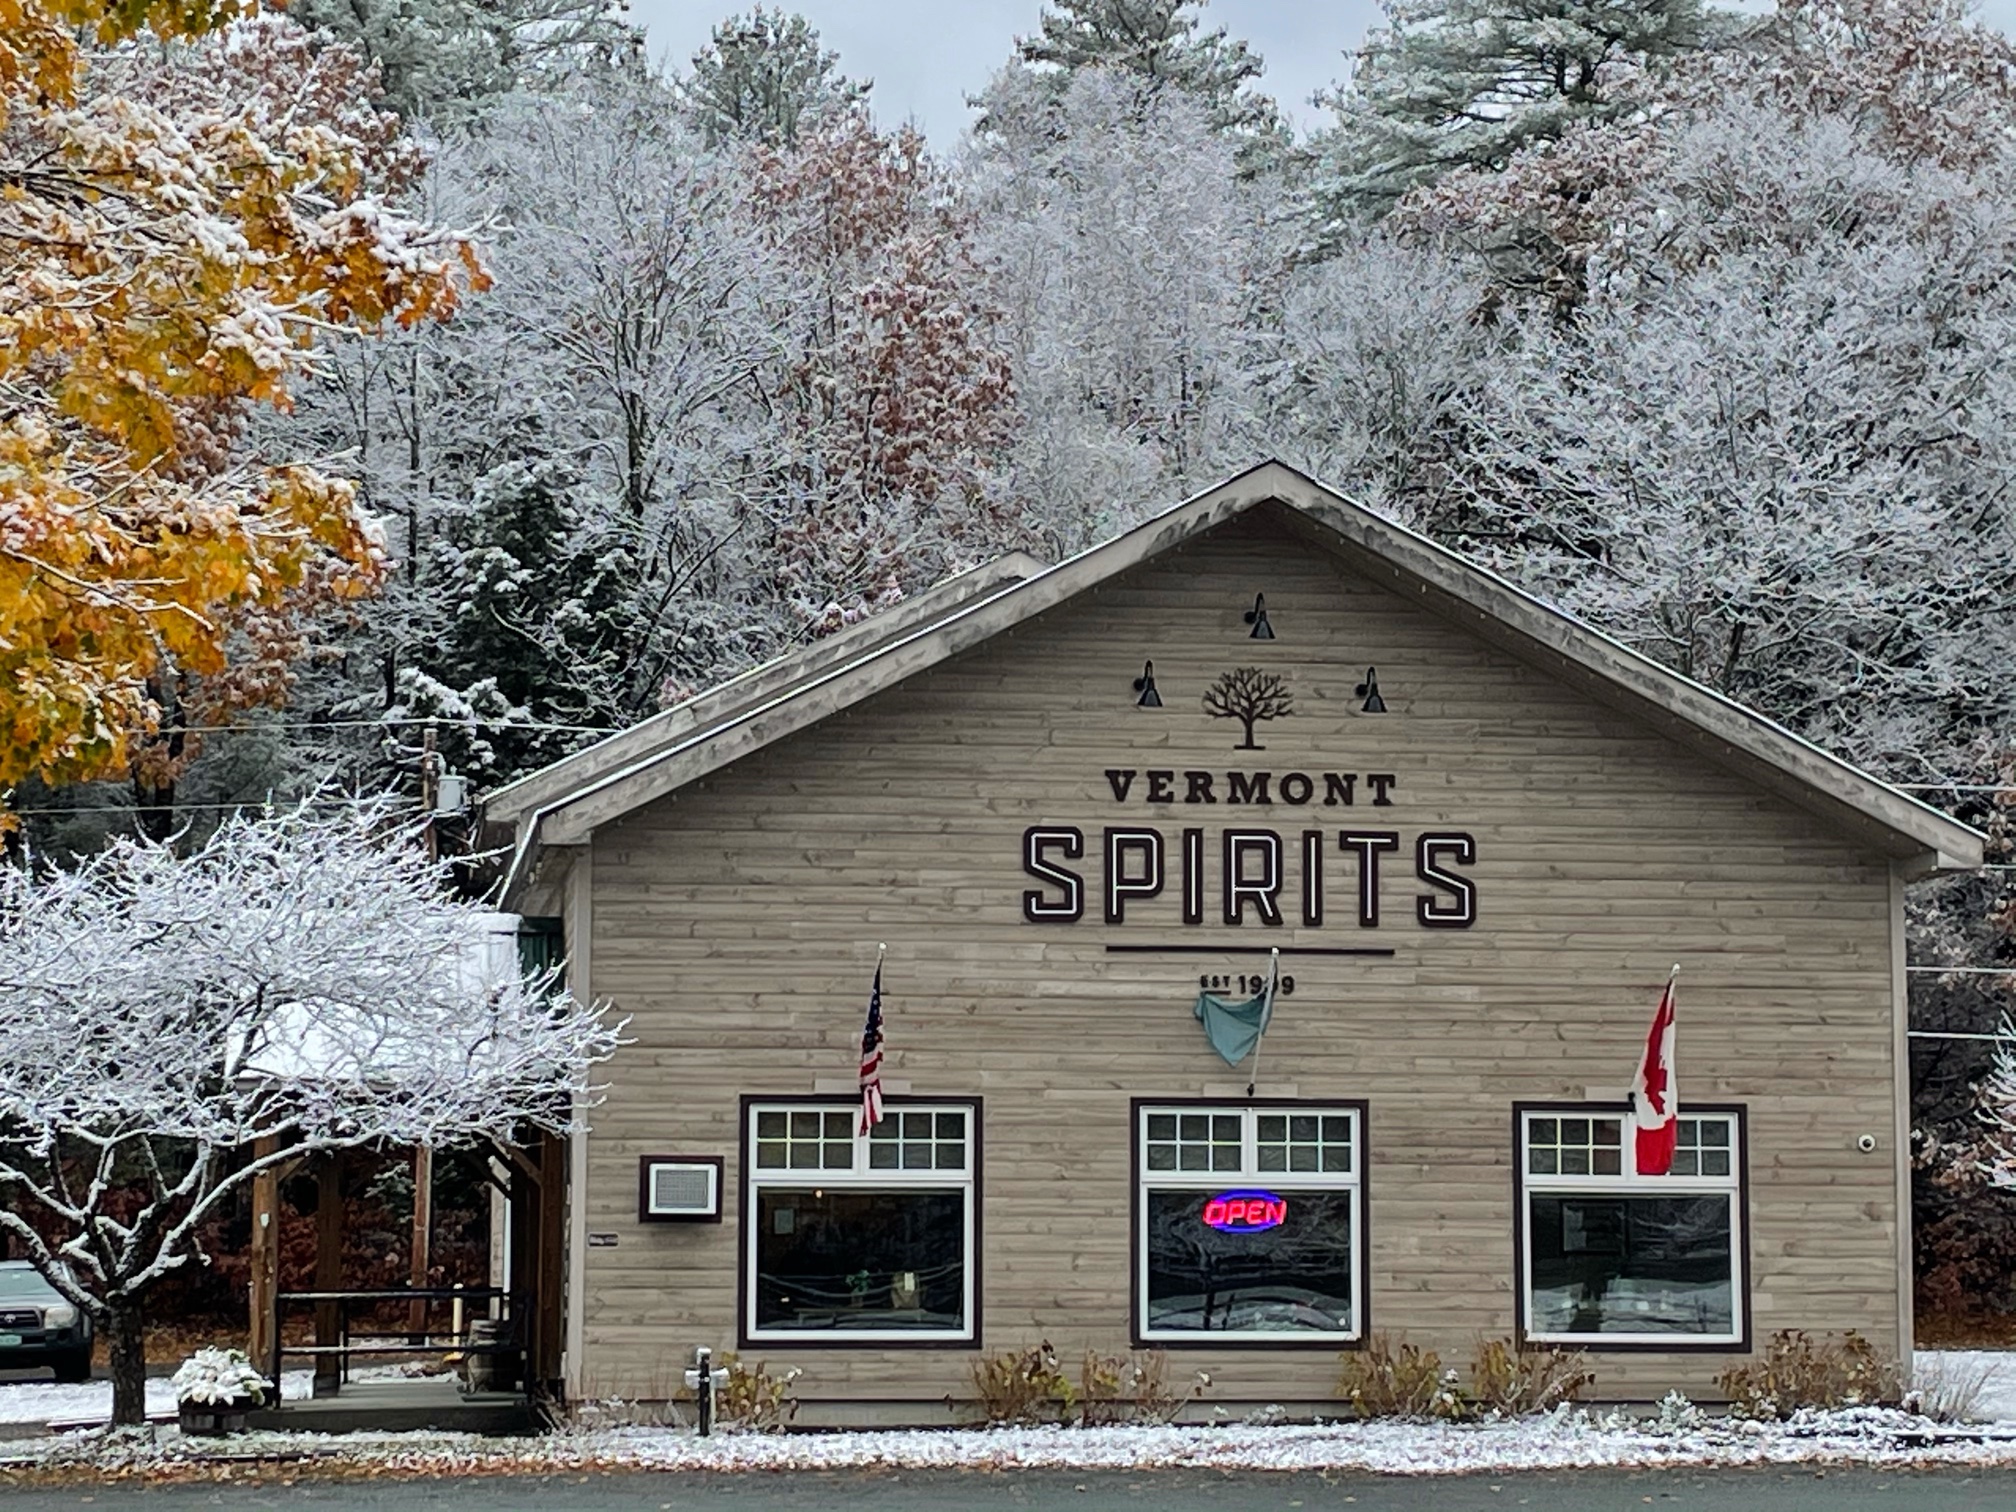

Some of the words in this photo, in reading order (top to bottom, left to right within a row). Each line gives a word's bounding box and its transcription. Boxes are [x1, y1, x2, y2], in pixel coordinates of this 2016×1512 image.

[1105, 770, 1396, 806] VERMONT
[1023, 826, 1476, 928] SPIRITS
[1200, 975, 1230, 988] EST
[1203, 1199, 1287, 1226] OPEN
